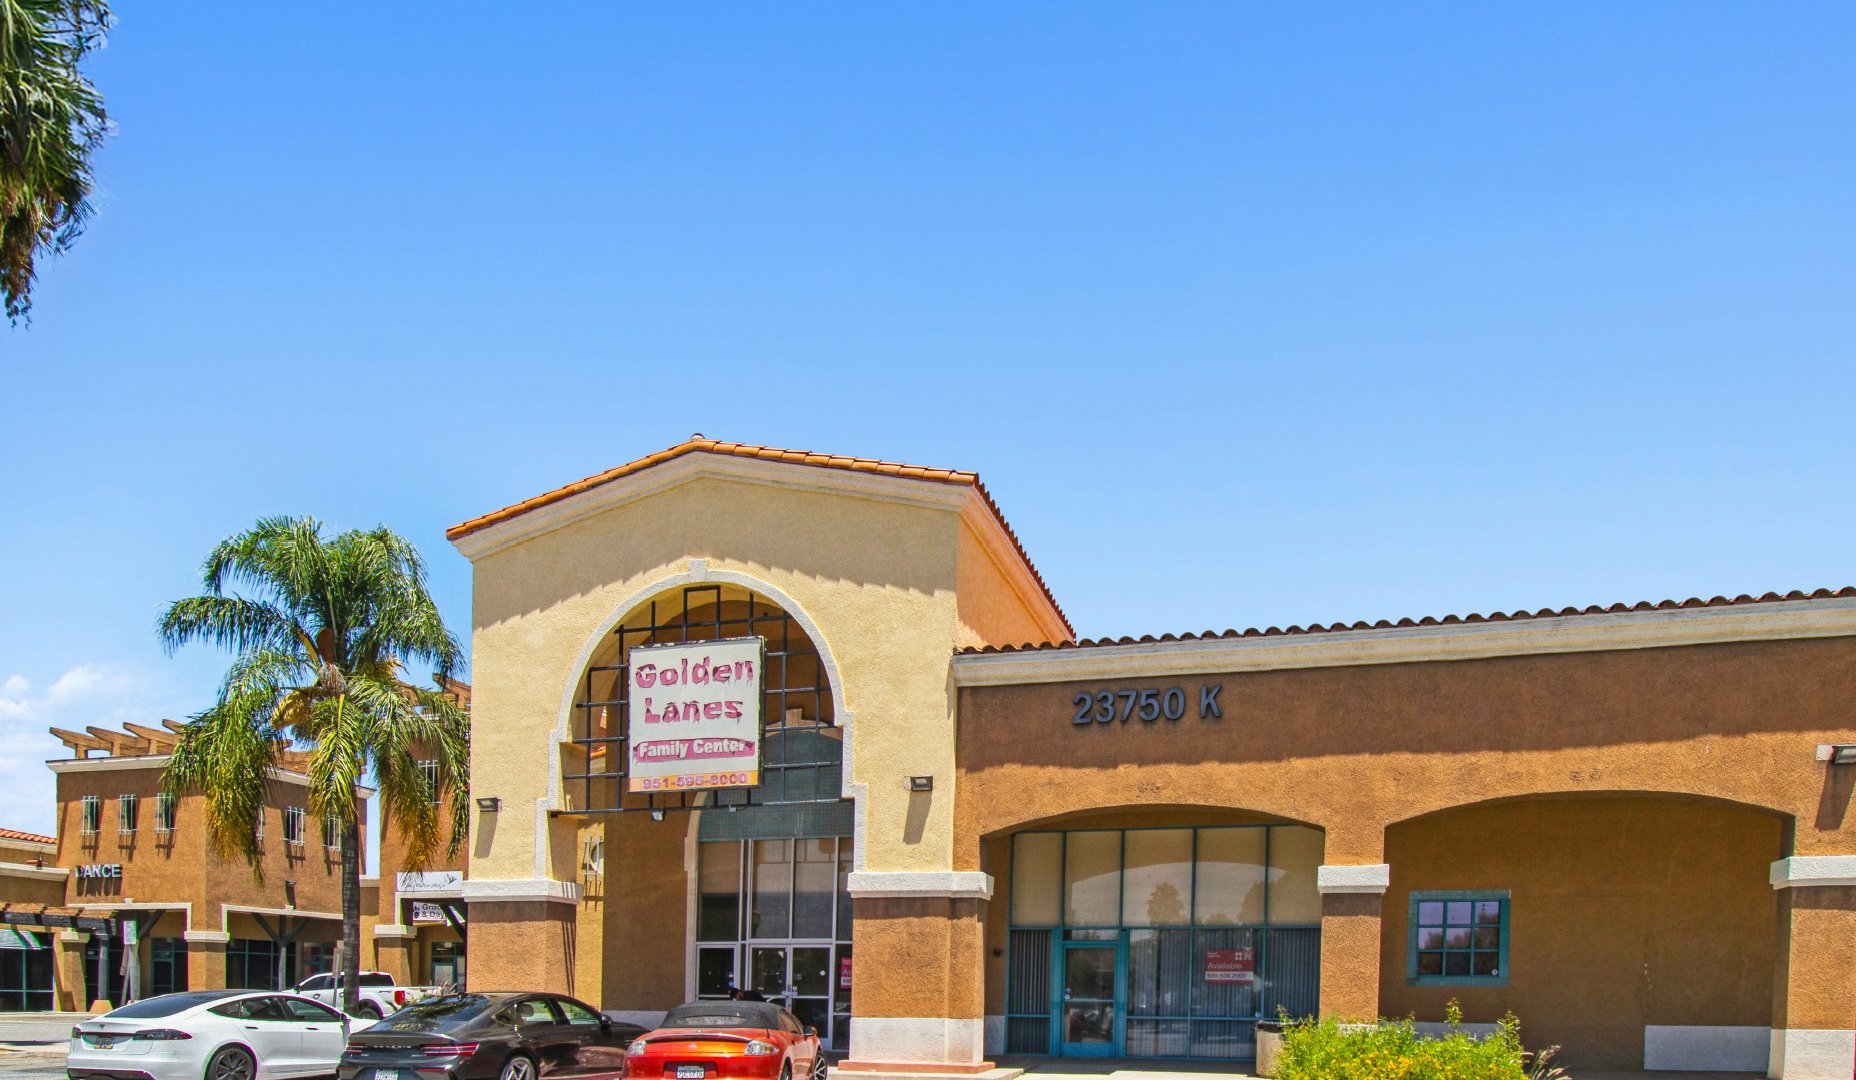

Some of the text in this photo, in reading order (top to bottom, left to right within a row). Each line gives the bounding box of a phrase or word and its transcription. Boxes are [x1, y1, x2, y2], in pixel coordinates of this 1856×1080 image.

[635, 656, 754, 688] Golden
[644, 697, 744, 725] Lanes
[1072, 683, 1223, 725] 23750 K
[639, 739, 746, 759] Family Center
[75, 863, 122, 878] DANCE
[1207, 962, 1242, 970] Available
